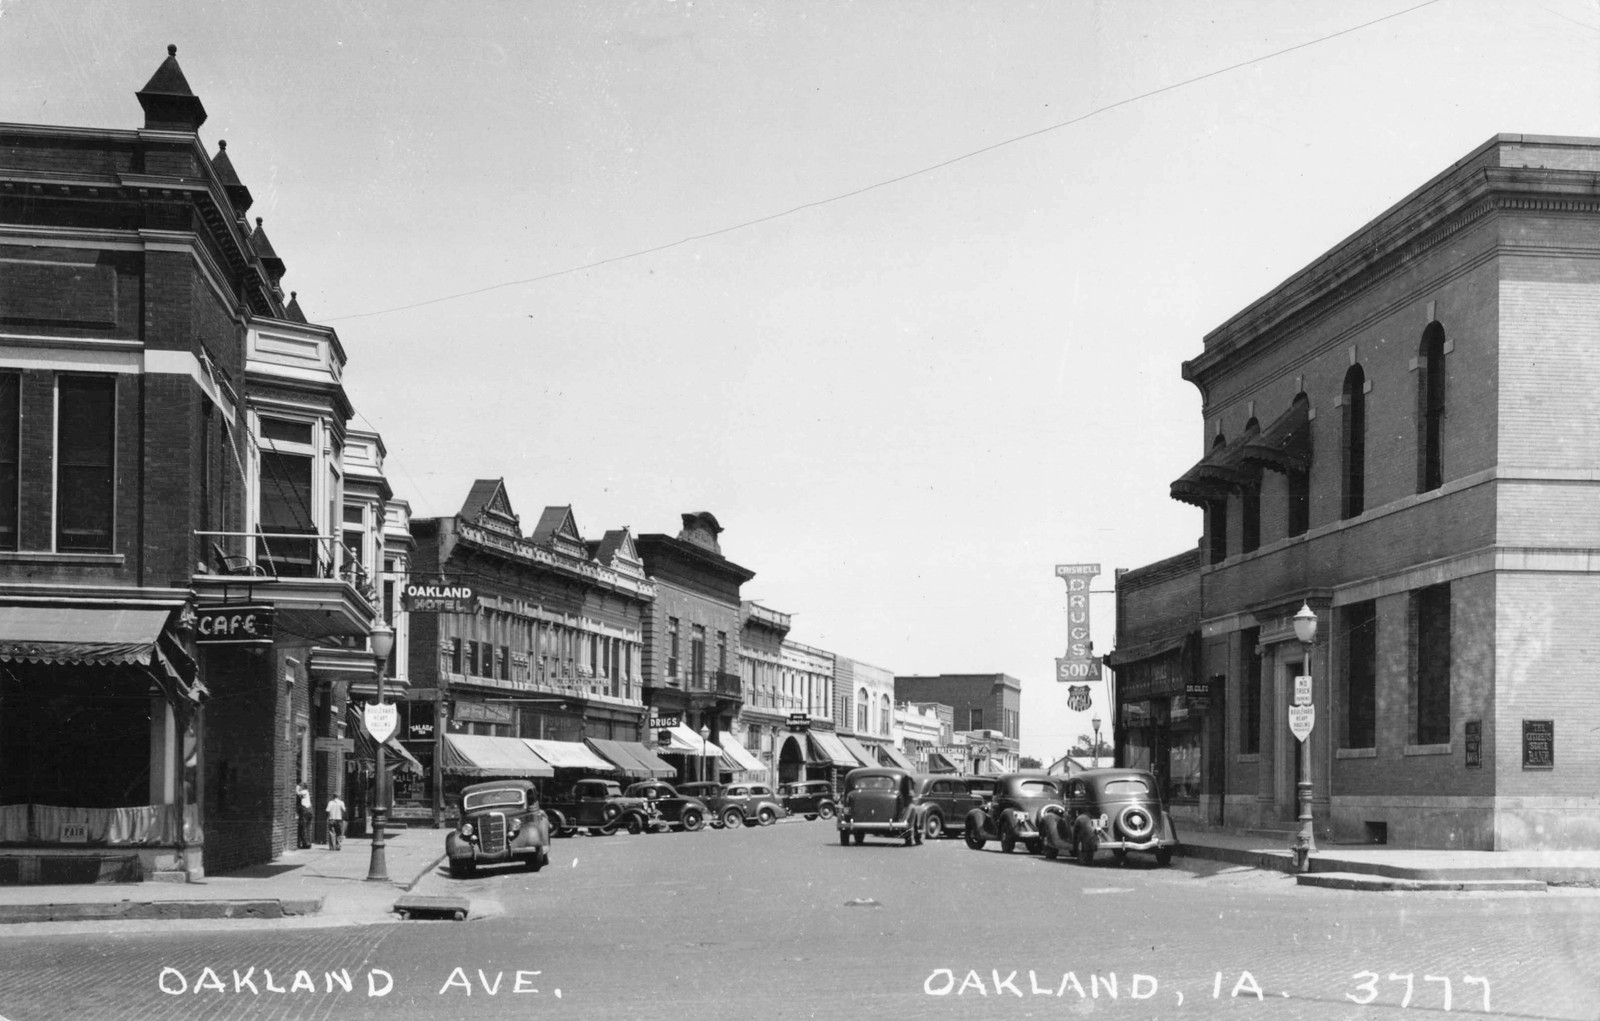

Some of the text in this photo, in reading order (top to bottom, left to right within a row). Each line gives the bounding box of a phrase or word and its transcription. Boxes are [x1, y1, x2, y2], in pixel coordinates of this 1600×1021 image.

[1057, 566, 1099, 575] CRISWELL
[407, 585, 472, 599] OAKLAND
[414, 598, 466, 611] HOTEL
[1069, 578, 1088, 656] DRUGS
[199, 614, 258, 635] CAFE
[1060, 663, 1098, 677] SODA
[650, 717, 677, 727] DRUGS
[1529, 741, 1548, 750] STATE
[1528, 750, 1550, 763] BANK
